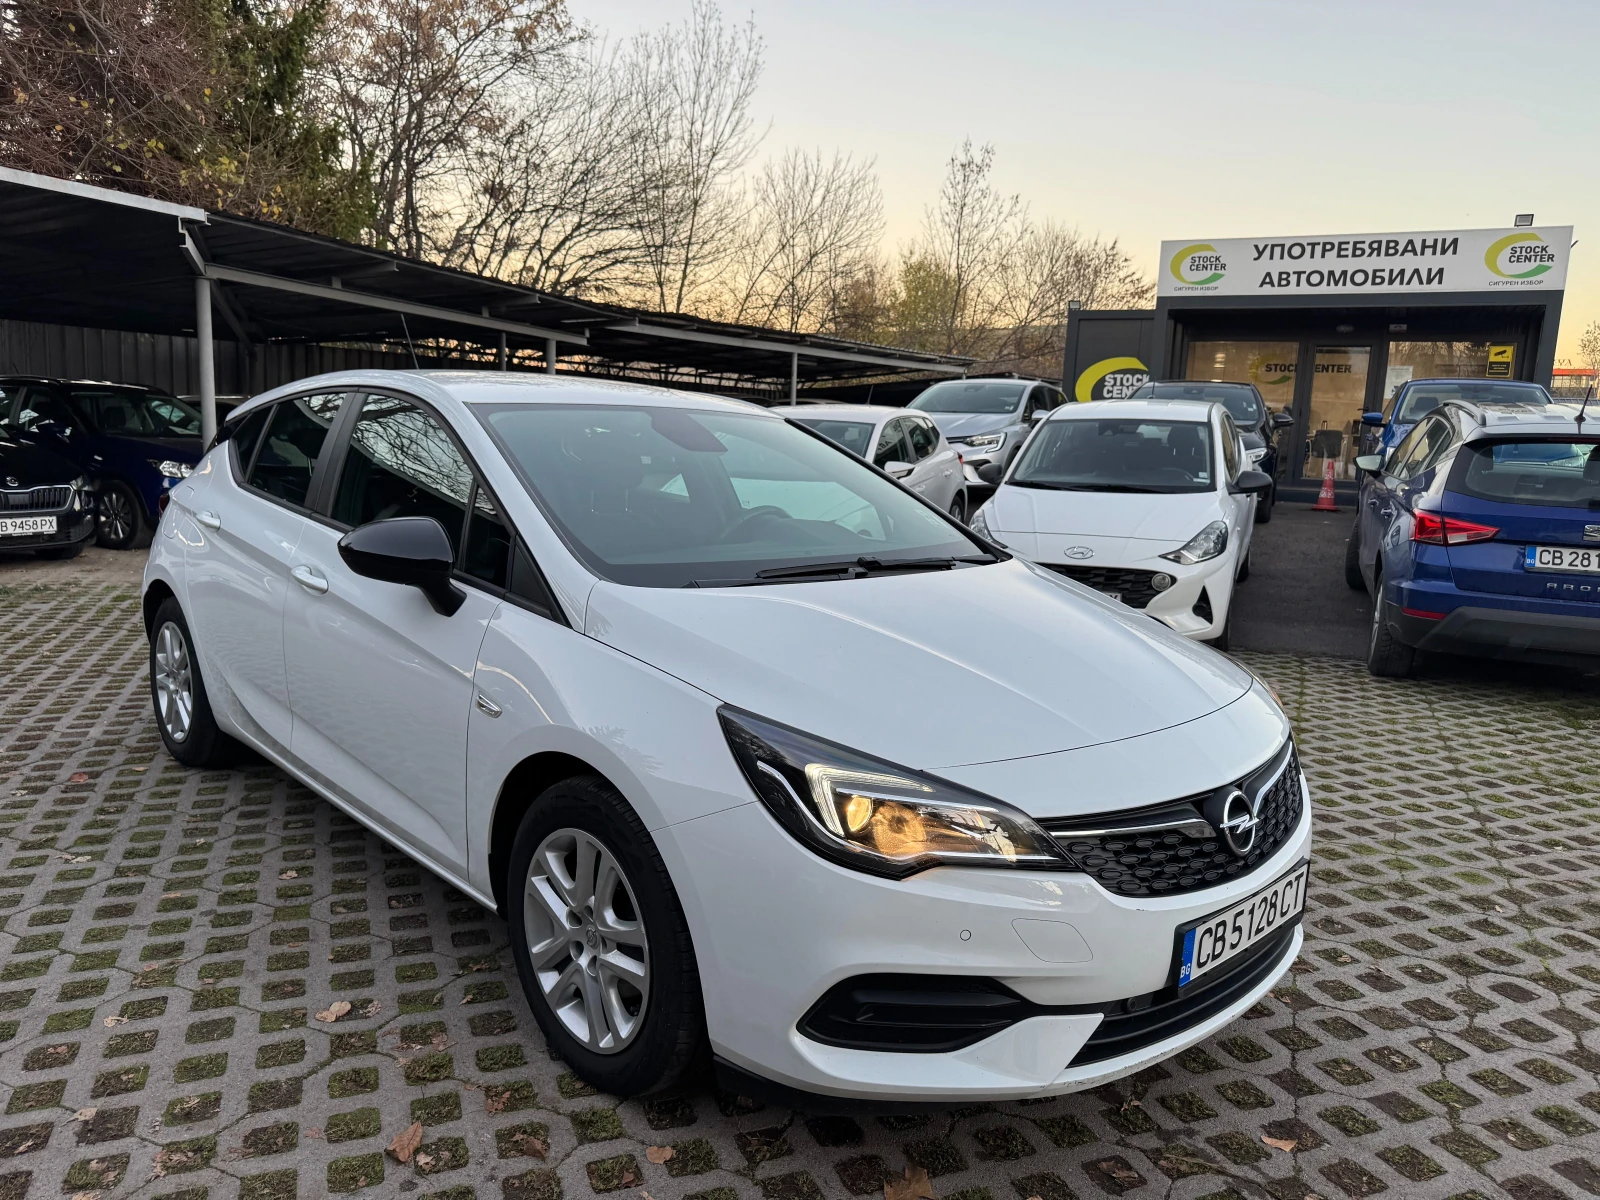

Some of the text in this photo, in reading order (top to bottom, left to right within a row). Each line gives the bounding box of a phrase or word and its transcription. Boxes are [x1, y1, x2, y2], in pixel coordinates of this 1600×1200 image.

[1253, 237, 1459, 261] УПОТРЕБЯВАНИ
[1510, 245, 1549, 255] STOCK
[1191, 255, 1221, 264] STOCK
[1508, 253, 1555, 264] CENTER
[1189, 263, 1227, 271] CENTER
[1258, 267, 1445, 288] АВТОМОБИЛИ
[1314, 364, 1352, 373] ENTER
[11, 519, 39, 532] 9458
[40, 518, 55, 530] PX
[1539, 549, 1563, 566] CB
[1197, 871, 1305, 969] CB 5128 CT
[1180, 962, 1191, 978] BG
